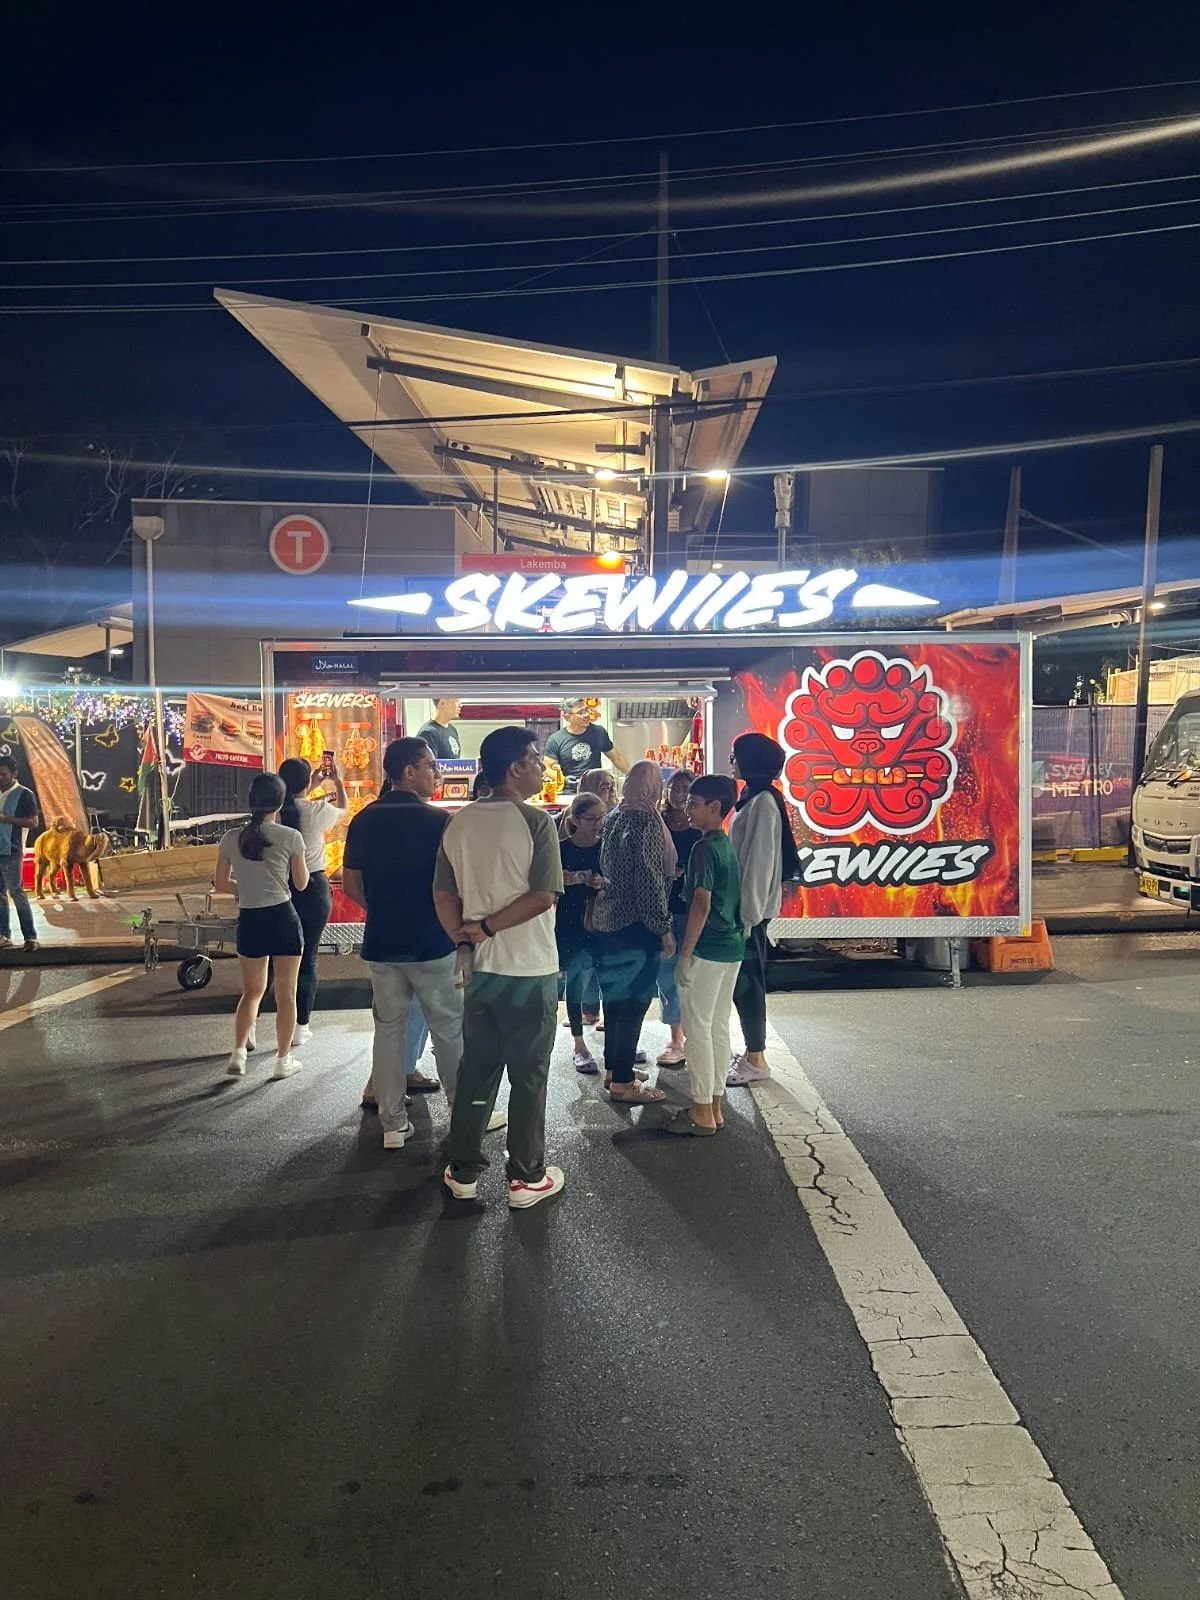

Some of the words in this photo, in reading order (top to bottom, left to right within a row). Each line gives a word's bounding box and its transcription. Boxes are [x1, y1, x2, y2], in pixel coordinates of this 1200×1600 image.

[286, 530, 313, 563] T
[520, 559, 567, 570] Lakemba
[434, 568, 858, 633] SKEWIIES
[315, 659, 334, 670] حلال
[294, 693, 376, 708] SKEWERS
[1051, 759, 1113, 780] sydney
[1051, 778, 1114, 798] METRO
